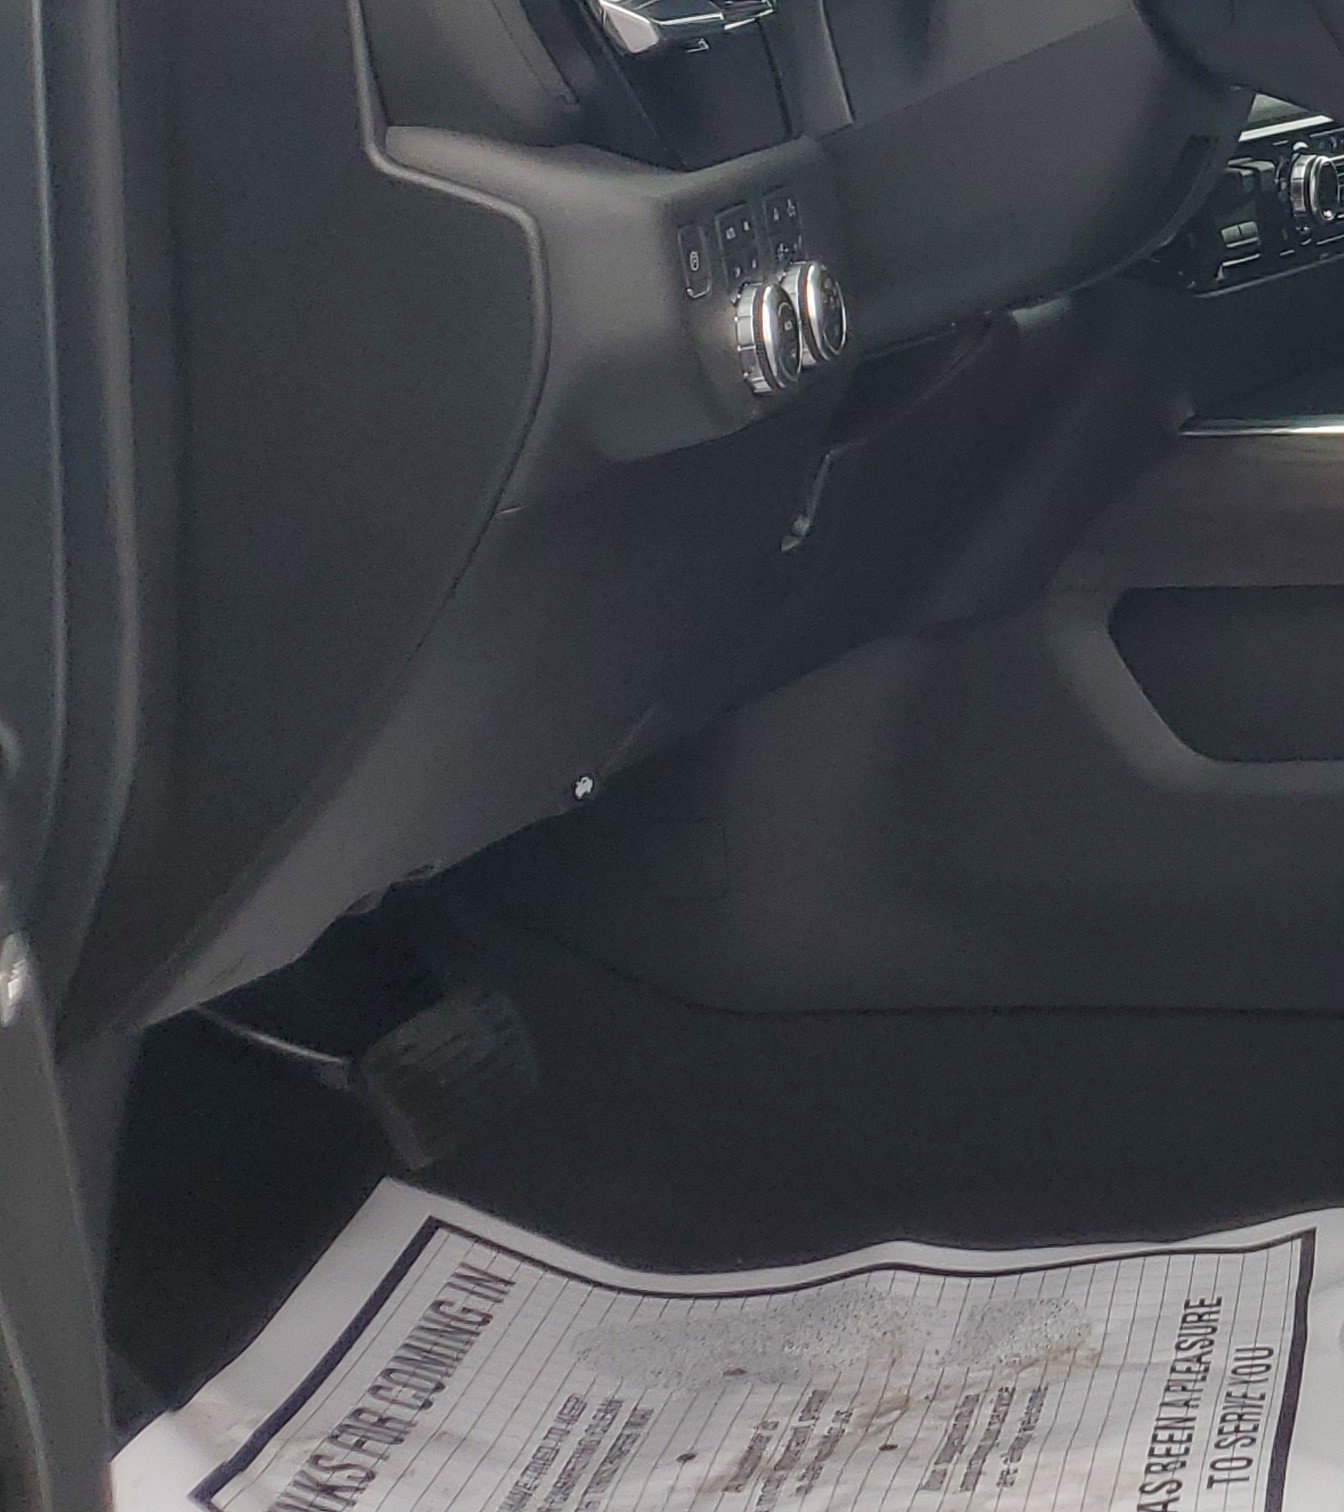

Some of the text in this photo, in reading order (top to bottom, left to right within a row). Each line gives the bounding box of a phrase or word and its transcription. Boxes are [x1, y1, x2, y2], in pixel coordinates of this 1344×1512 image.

[447, 1262, 517, 1303] IN
[367, 1299, 494, 1411] COMING
[1165, 1296, 1223, 1393] PLEASURE
[1159, 1396, 1202, 1409] A
[1206, 1344, 1275, 1490] TO SERVE YOU
[327, 1406, 419, 1461] FOR
[1145, 1416, 1197, 1475] BEEN
